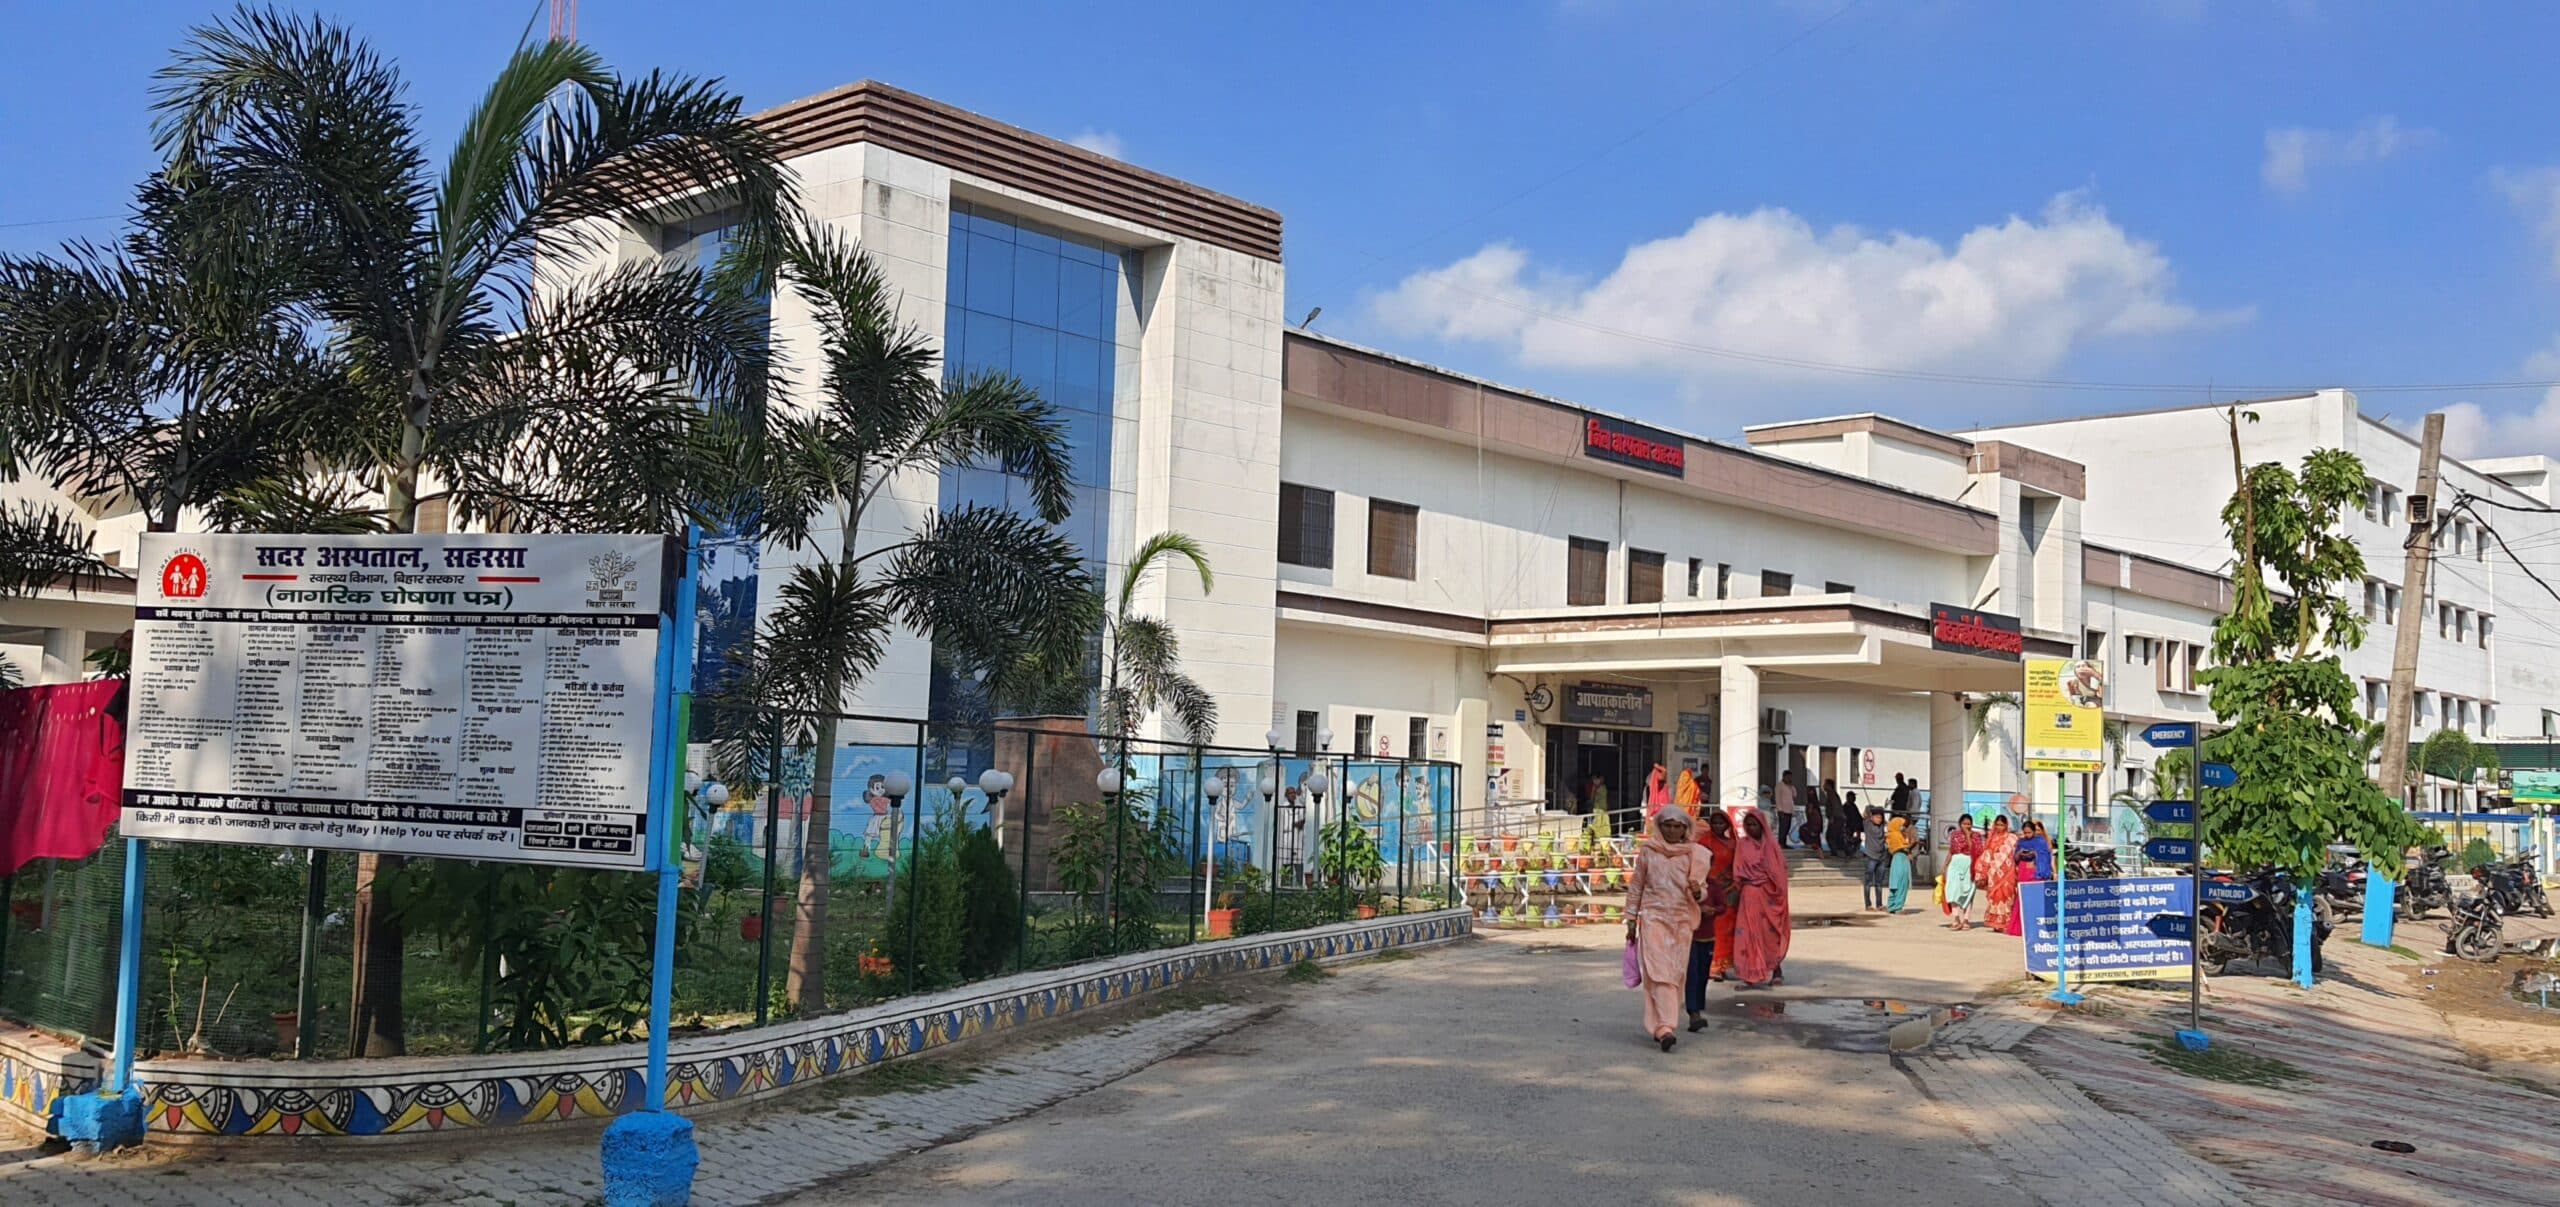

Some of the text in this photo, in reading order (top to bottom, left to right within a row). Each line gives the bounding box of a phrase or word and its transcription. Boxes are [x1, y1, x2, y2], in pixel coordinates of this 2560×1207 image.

[255, 546, 528, 572] सदर अस्पताल, सहरसा
[393, 571, 423, 585] बिहार
[426, 573, 465, 585] सरकार
[265, 583, 513, 611] (नागरिक घोषणा पत्र)
[586, 598, 636, 609] बिहार सरकार
[1576, 692, 1642, 711] आपातकालीन
[2151, 730, 2186, 740] EMERGENCY
[152, 794, 179, 806] आपके
[198, 795, 225, 809] आपके
[261, 798, 271, 811] के
[135, 811, 161, 823] किसी
[163, 811, 175, 823] भी
[178, 814, 205, 825] प्रकार
[207, 815, 222, 826] की
[225, 817, 271, 829] जानकारी
[272, 821, 296, 831] प्राप्त
[346, 824, 370, 837] May
[380, 826, 406, 839] Help
[410, 827, 433, 838] You
[436, 829, 451, 838] पर
[2044, 887, 2086, 897] Coplain
[2087, 885, 2105, 894] Box
[2208, 887, 2246, 899] PATHOLOGY
